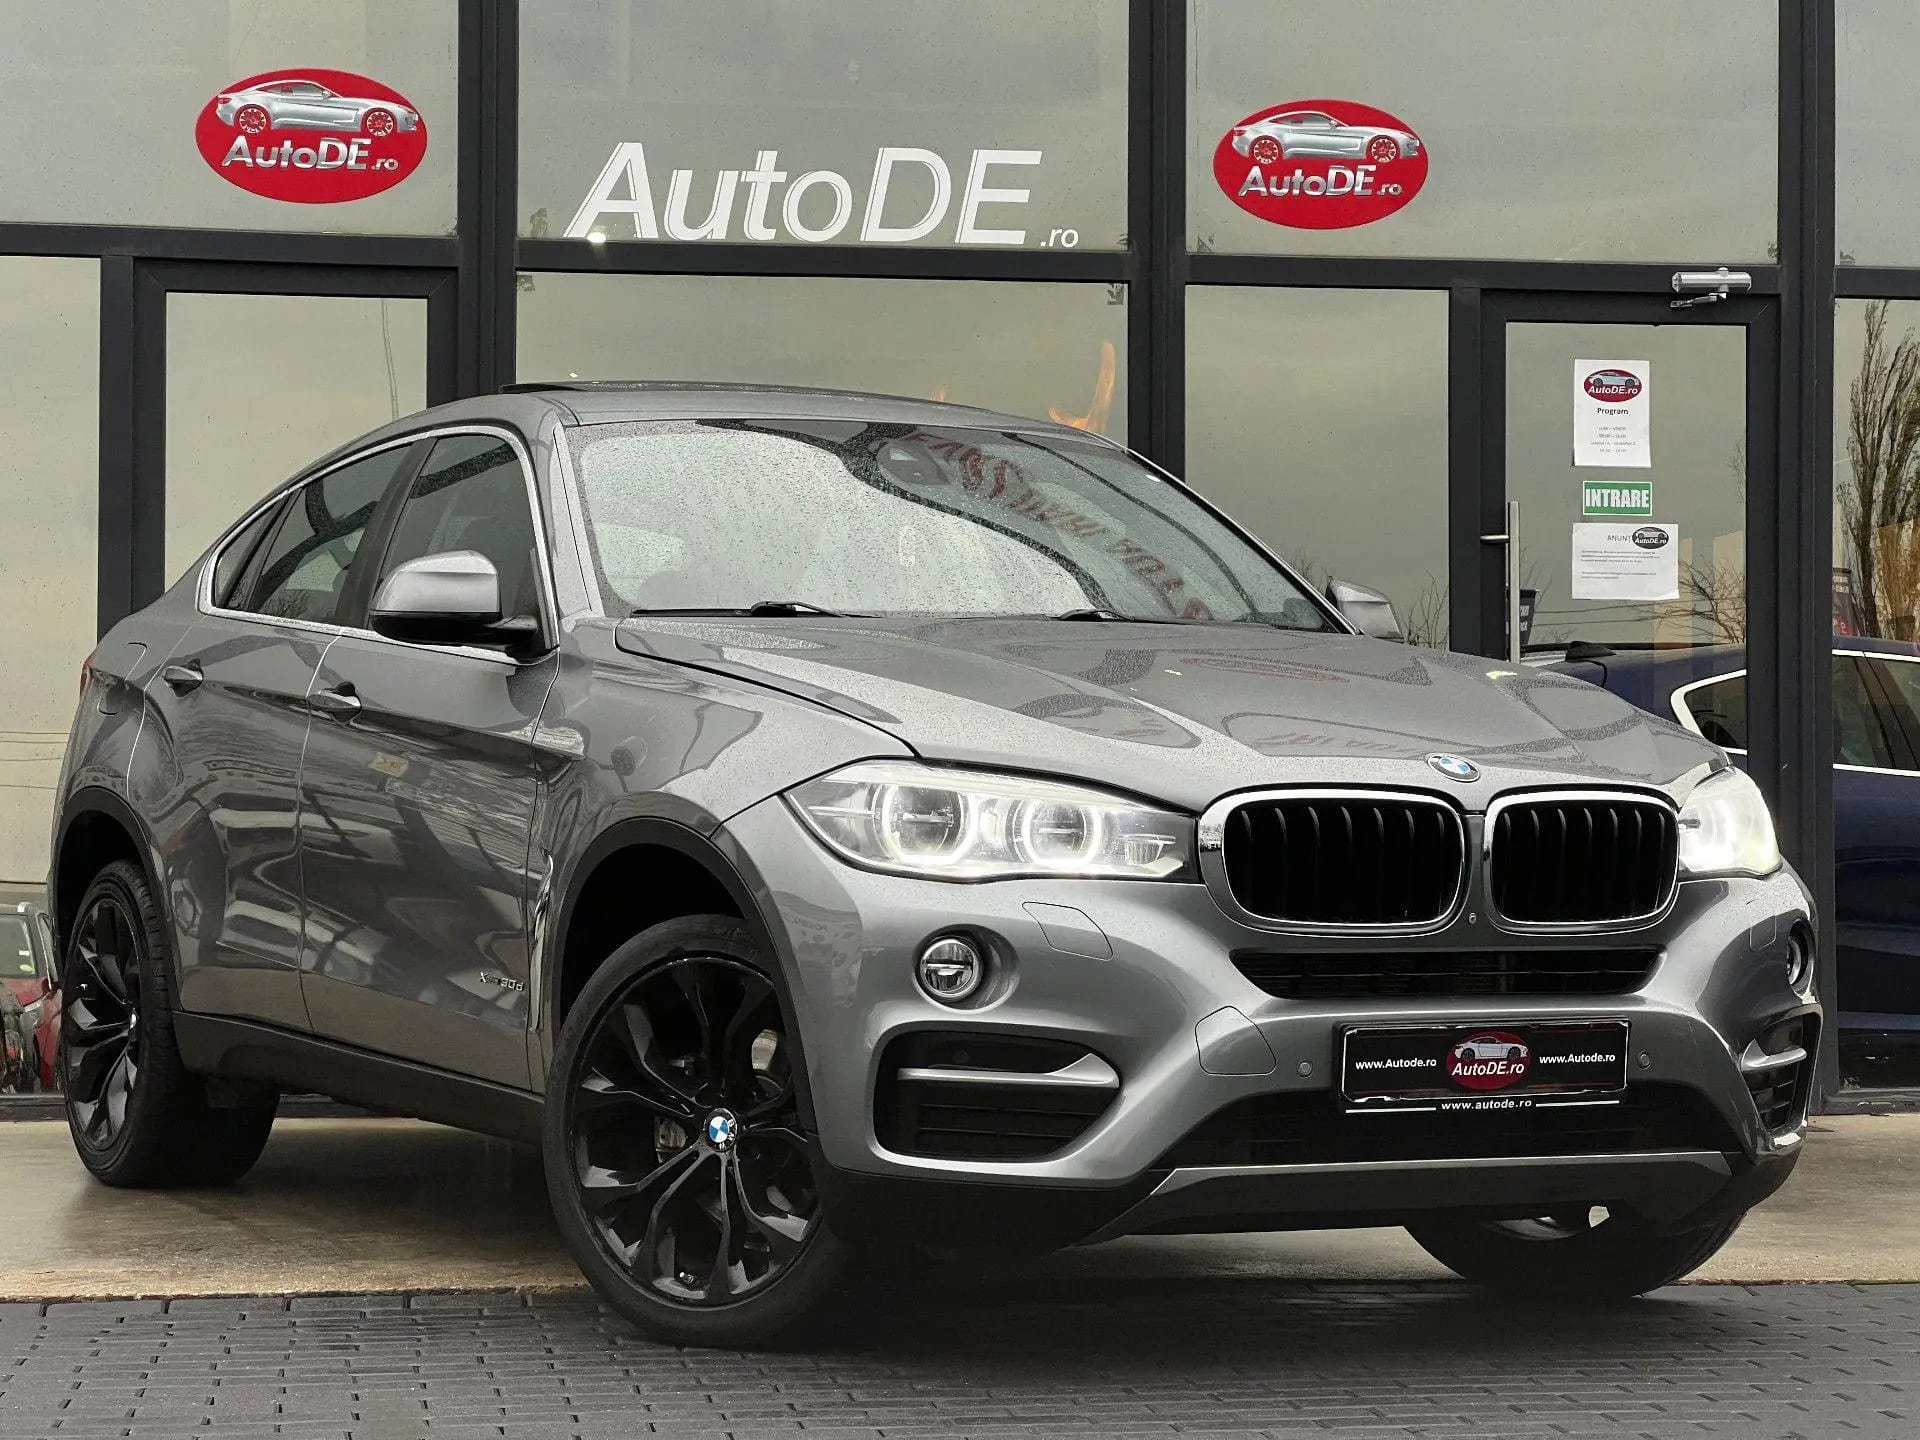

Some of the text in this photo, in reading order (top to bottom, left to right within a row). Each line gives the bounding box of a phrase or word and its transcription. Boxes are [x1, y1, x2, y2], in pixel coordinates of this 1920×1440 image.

[1588, 386, 1638, 395] AutoDE.ro
[1597, 407, 1629, 416] Program
[1585, 488, 1650, 508] INTRARE
[1355, 1057, 1437, 1070] www.Autode.ro
[1539, 1052, 1616, 1064] www.Autode.ro
[1451, 1061, 1525, 1077] AutoDE.ro
[1441, 1098, 1532, 1111] www.autode.ro
